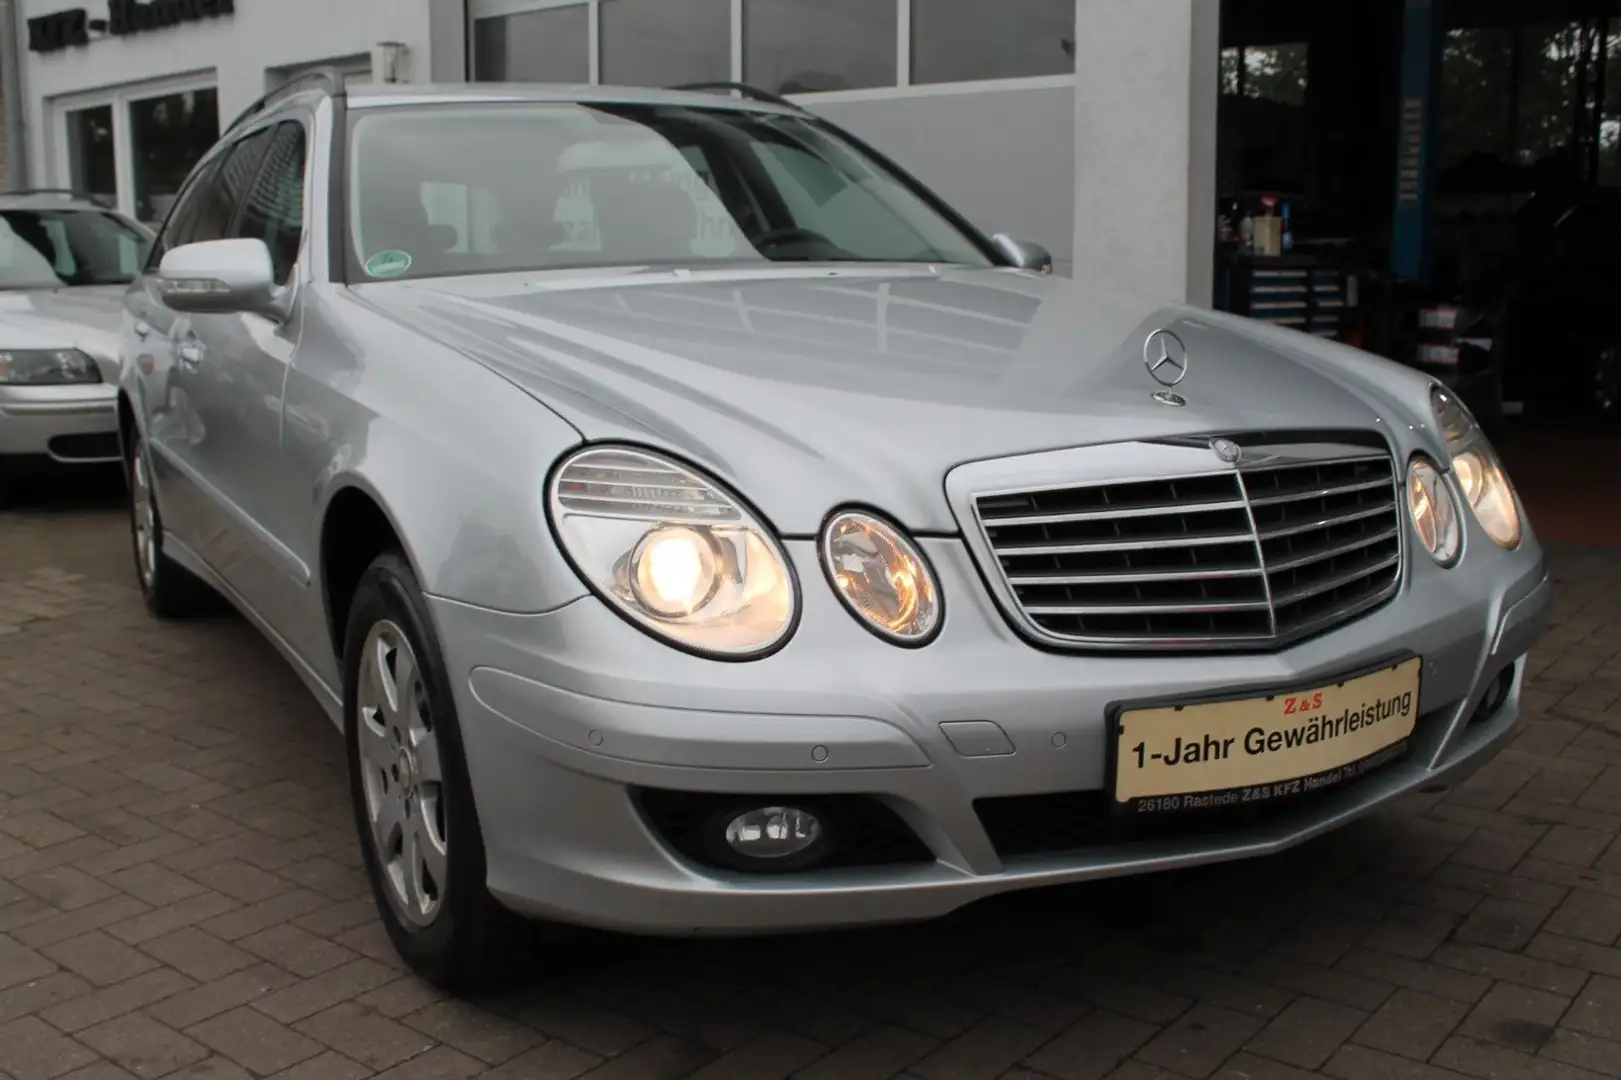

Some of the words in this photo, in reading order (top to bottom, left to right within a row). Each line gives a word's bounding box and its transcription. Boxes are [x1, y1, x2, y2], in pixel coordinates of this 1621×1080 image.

[1132, 733, 1235, 768] 1-Jahr
[1243, 690, 1412, 755] Gewährleistung
[1137, 796, 1179, 812] 26180
[1183, 791, 1239, 808] Rastede
[1241, 786, 1270, 802] Z&S
[1273, 780, 1301, 797] KFZ
[1303, 768, 1343, 791] Handel
